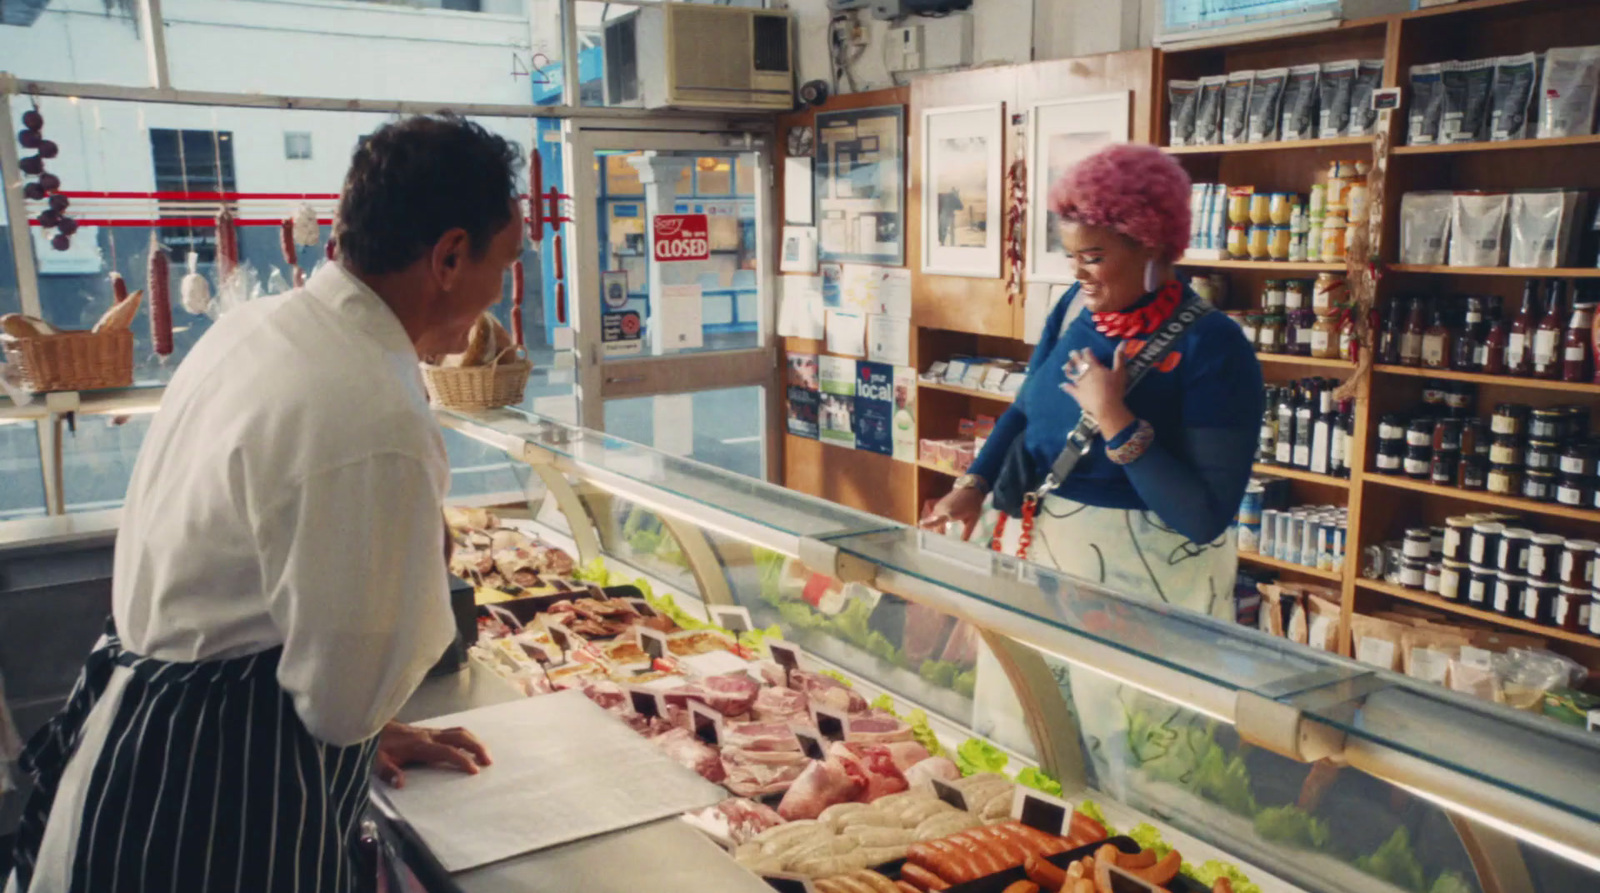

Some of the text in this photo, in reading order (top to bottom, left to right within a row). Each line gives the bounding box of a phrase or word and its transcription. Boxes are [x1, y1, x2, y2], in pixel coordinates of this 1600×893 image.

[656, 239, 707, 257] CLOSED
[871, 374, 887, 383] your
[858, 378, 892, 402] local
